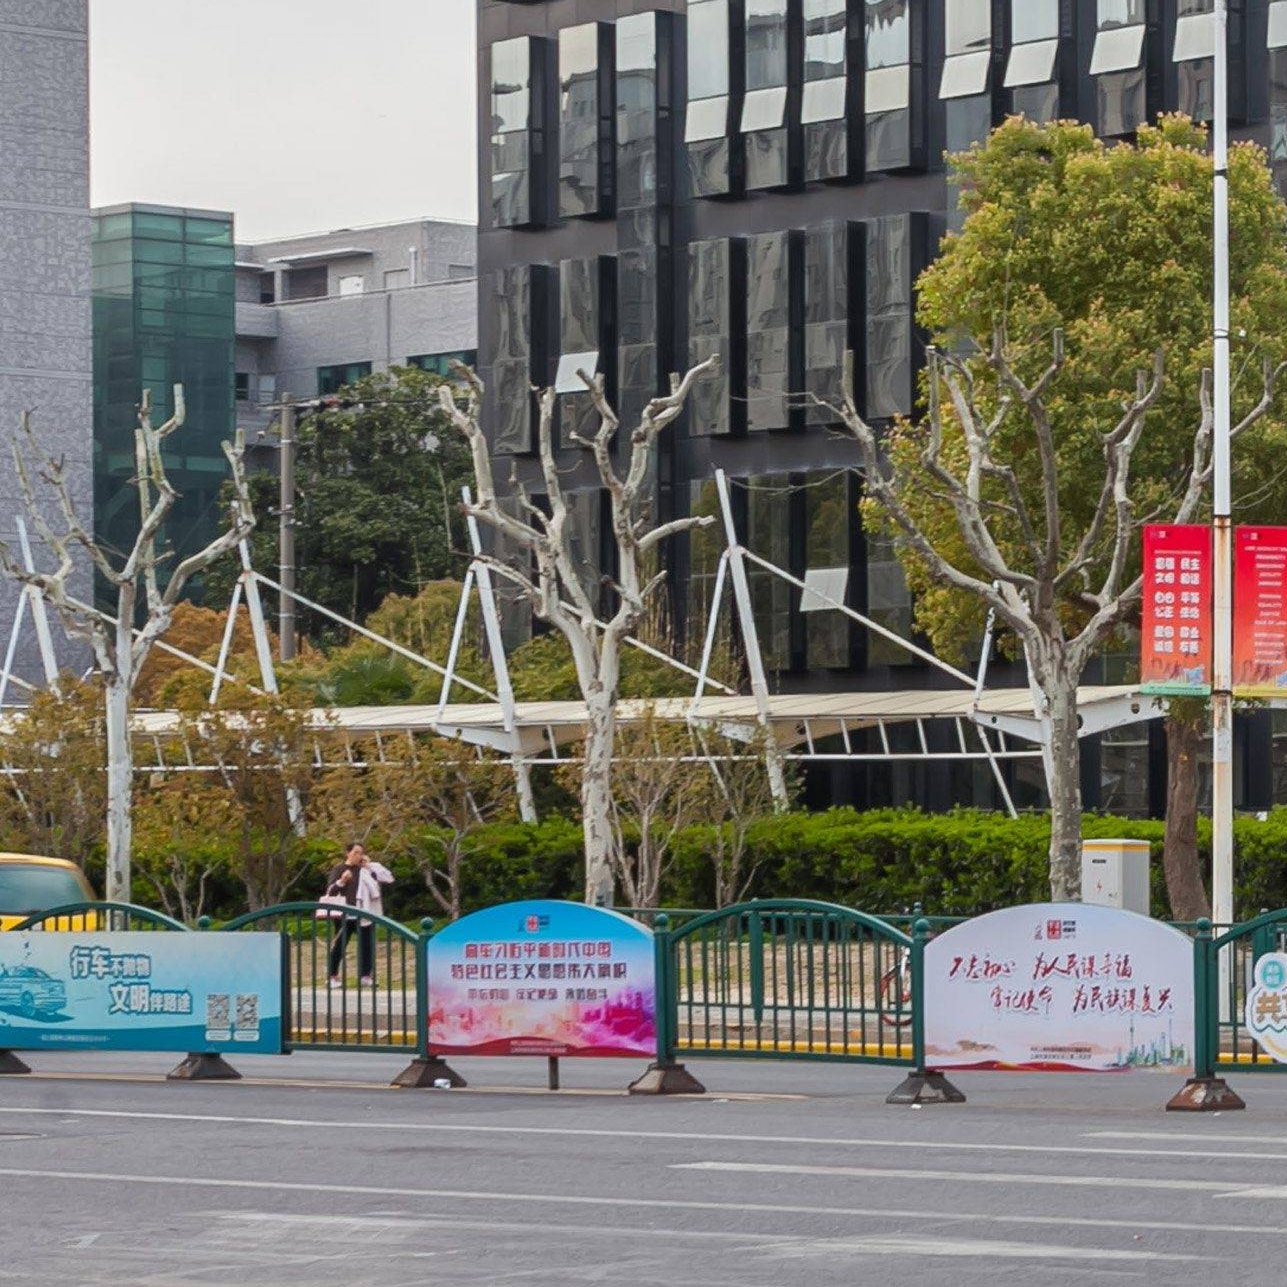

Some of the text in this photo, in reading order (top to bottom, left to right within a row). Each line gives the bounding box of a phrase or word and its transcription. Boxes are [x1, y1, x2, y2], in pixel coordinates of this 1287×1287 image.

[1033, 952, 1132, 980] 为人民谋幸福
[991, 984, 1173, 1014] 牢记使命 为民族谋复兴
